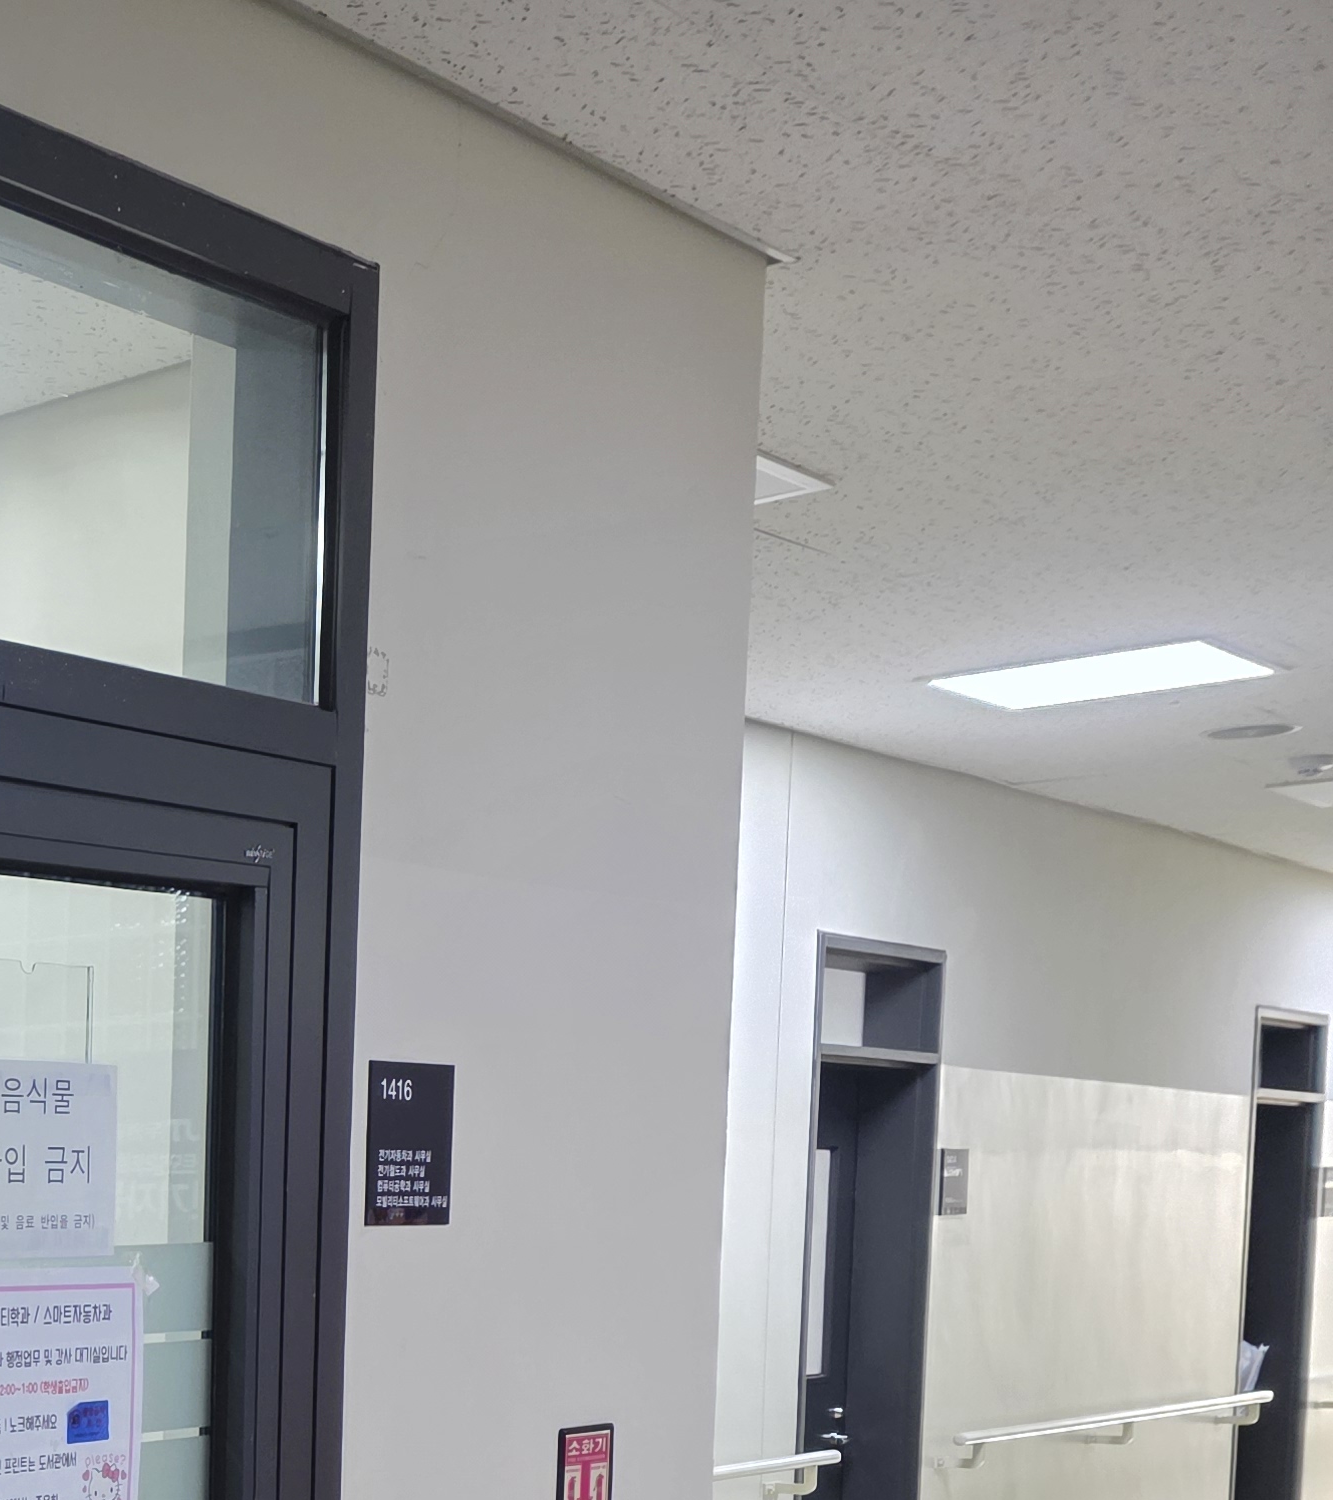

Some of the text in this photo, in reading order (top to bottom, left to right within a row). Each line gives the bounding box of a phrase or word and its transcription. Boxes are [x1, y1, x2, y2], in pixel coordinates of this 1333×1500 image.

[1, 1077, 74, 1115] 음식물
[381, 1078, 413, 1101] 1416
[44, 1145, 91, 1184] 금지
[378, 1149, 432, 1163] 전기자동차과 사무실
[377, 1164, 426, 1178] 전기철도과 사무실
[376, 1179, 430, 1193] 컴퓨터공학과 사무실
[431, 1195, 448, 1208] 사무실
[0, 1215, 10, 1230] 및
[15, 1214, 35, 1230] 음료
[41, 1214, 68, 1229] 반입을
[73, 1213, 95, 1230] 금지)
[43, 1304, 112, 1325] 스마트자동차과
[6, 1349, 41, 1368] 행정업무
[44, 1348, 53, 1366] 및
[55, 1348, 72, 1365] 강사
[75, 1345, 128, 1364] 대기실입니다
[40, 1378, 89, 1395] (학생출입금지)
[10, 1414, 58, 1433] 노크해주세요
[568, 1437, 606, 1456] 소화기
[5, 1456, 36, 1474] 프린트는
[39, 1452, 77, 1471] 도서관에서
[85, 1454, 126, 1468] please?
